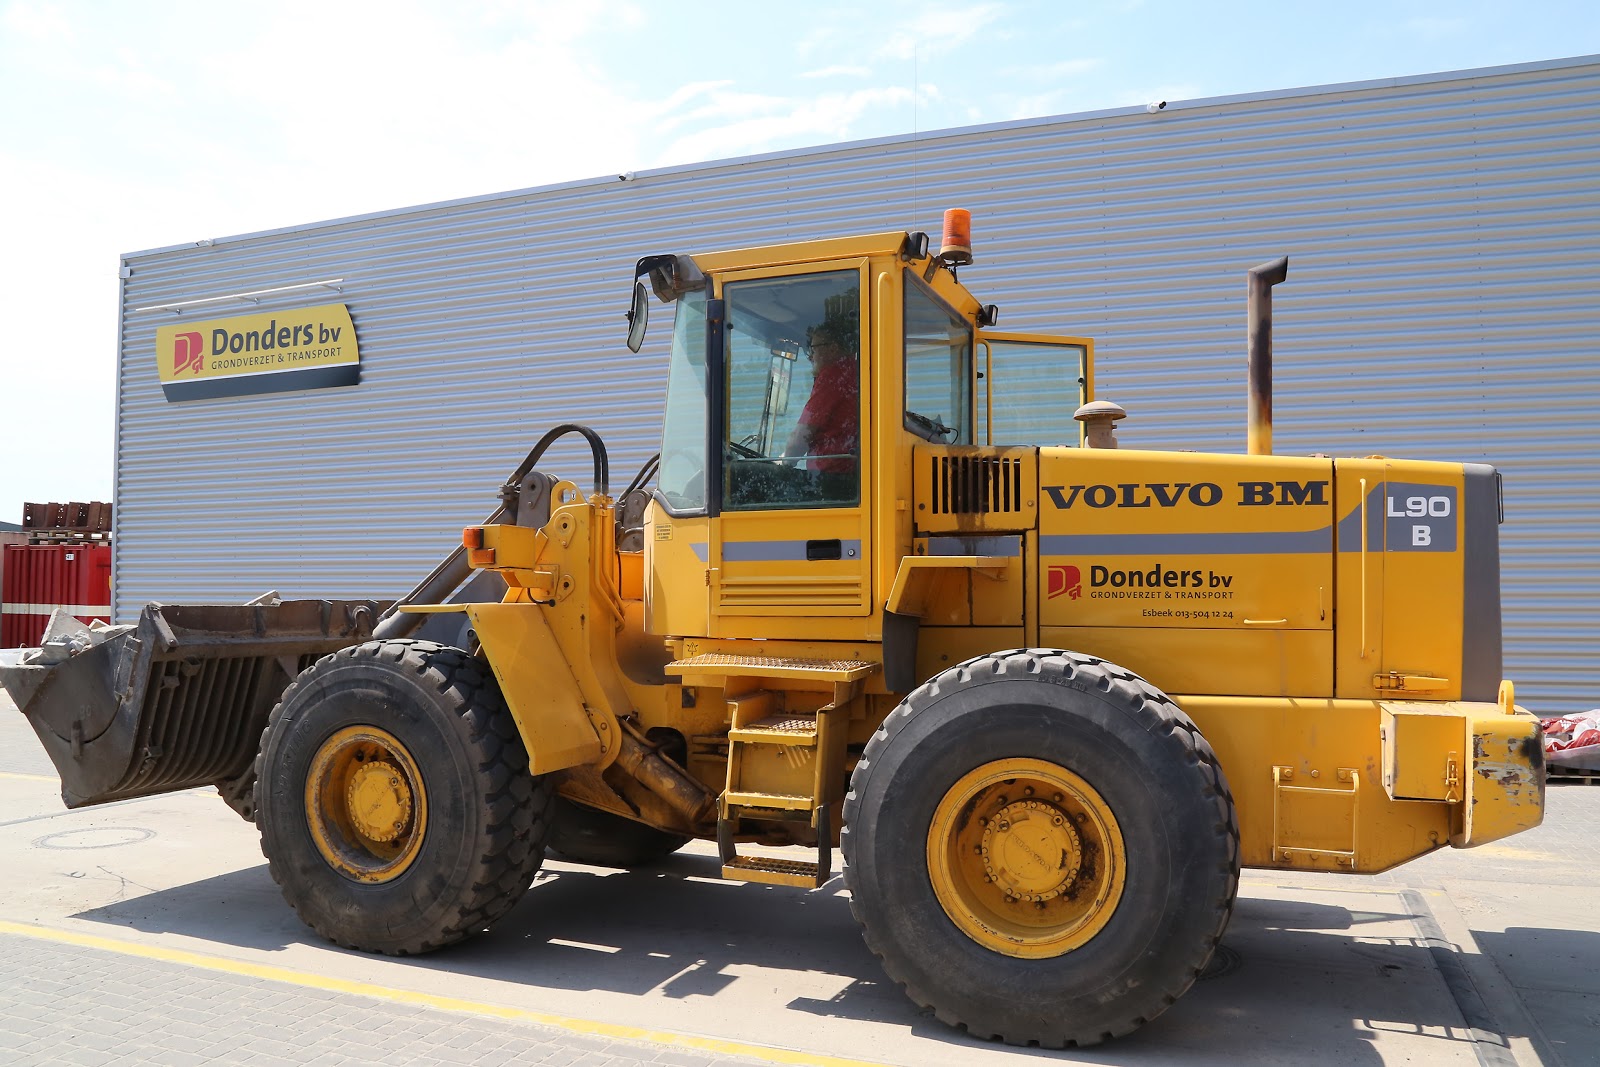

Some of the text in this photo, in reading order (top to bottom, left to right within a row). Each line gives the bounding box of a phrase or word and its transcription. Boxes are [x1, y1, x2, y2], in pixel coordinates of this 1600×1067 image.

[211, 319, 342, 356] Donders bv
[211, 346, 342, 370] GRONDVERZET & TRANSPORT
[1041, 480, 1329, 509] VOLVO BM
[1387, 496, 1451, 518] L90
[1412, 525, 1432, 546] B
[1090, 563, 1234, 588] Donders bv
[1090, 591, 1234, 599] GRONDVERZET & TRANSPORT
[1142, 608, 1234, 619] Esbeek 013-504 12 24
